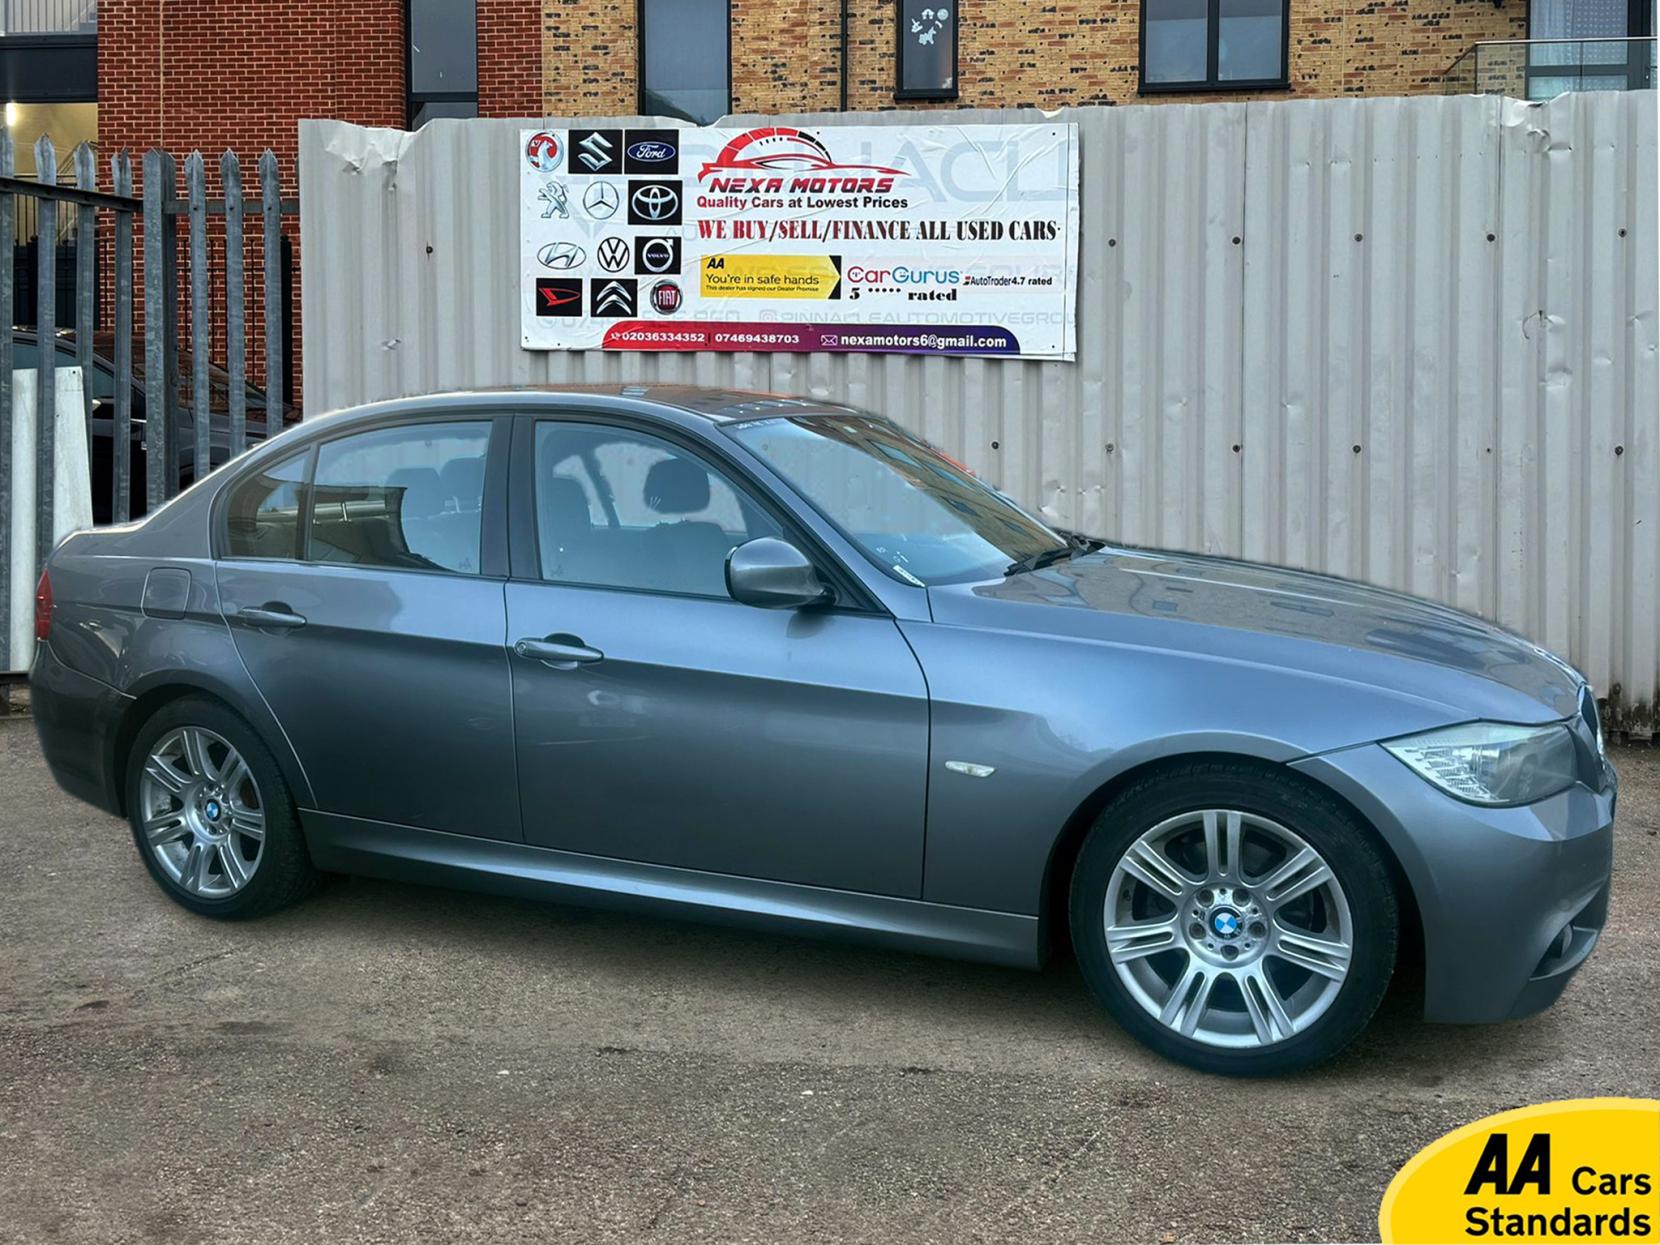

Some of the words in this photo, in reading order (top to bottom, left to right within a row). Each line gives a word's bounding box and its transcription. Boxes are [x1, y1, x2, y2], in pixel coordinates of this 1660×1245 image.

[636, 144, 666, 159] Ford
[709, 178, 783, 194] NEXA
[789, 178, 895, 194] MOTORS
[696, 196, 746, 211] Quality
[751, 196, 784, 209] Cars
[788, 197, 803, 209] at
[807, 197, 859, 209] Lowest
[863, 196, 908, 209] Prices
[697, 220, 727, 240] WE
[733, 220, 911, 242] BUY/SELL/FINANCE
[916, 220, 950, 240] ALL
[956, 220, 1004, 241] USED
[1008, 220, 1057, 241] CARS
[706, 257, 725, 269] AA
[705, 274, 741, 284] You're
[744, 274, 754, 284] in
[757, 274, 781, 285] safe
[784, 275, 820, 285] hands
[847, 266, 960, 284] CarGurus
[1028, 277, 1053, 286] rated
[658, 290, 677, 306] FIAT
[849, 287, 860, 300] 5
[908, 288, 957, 301] rated
[622, 332, 705, 342] 02036334352
[715, 333, 800, 344] 07469438703
[841, 335, 1007, 350] nexamotors6@gmail.com
